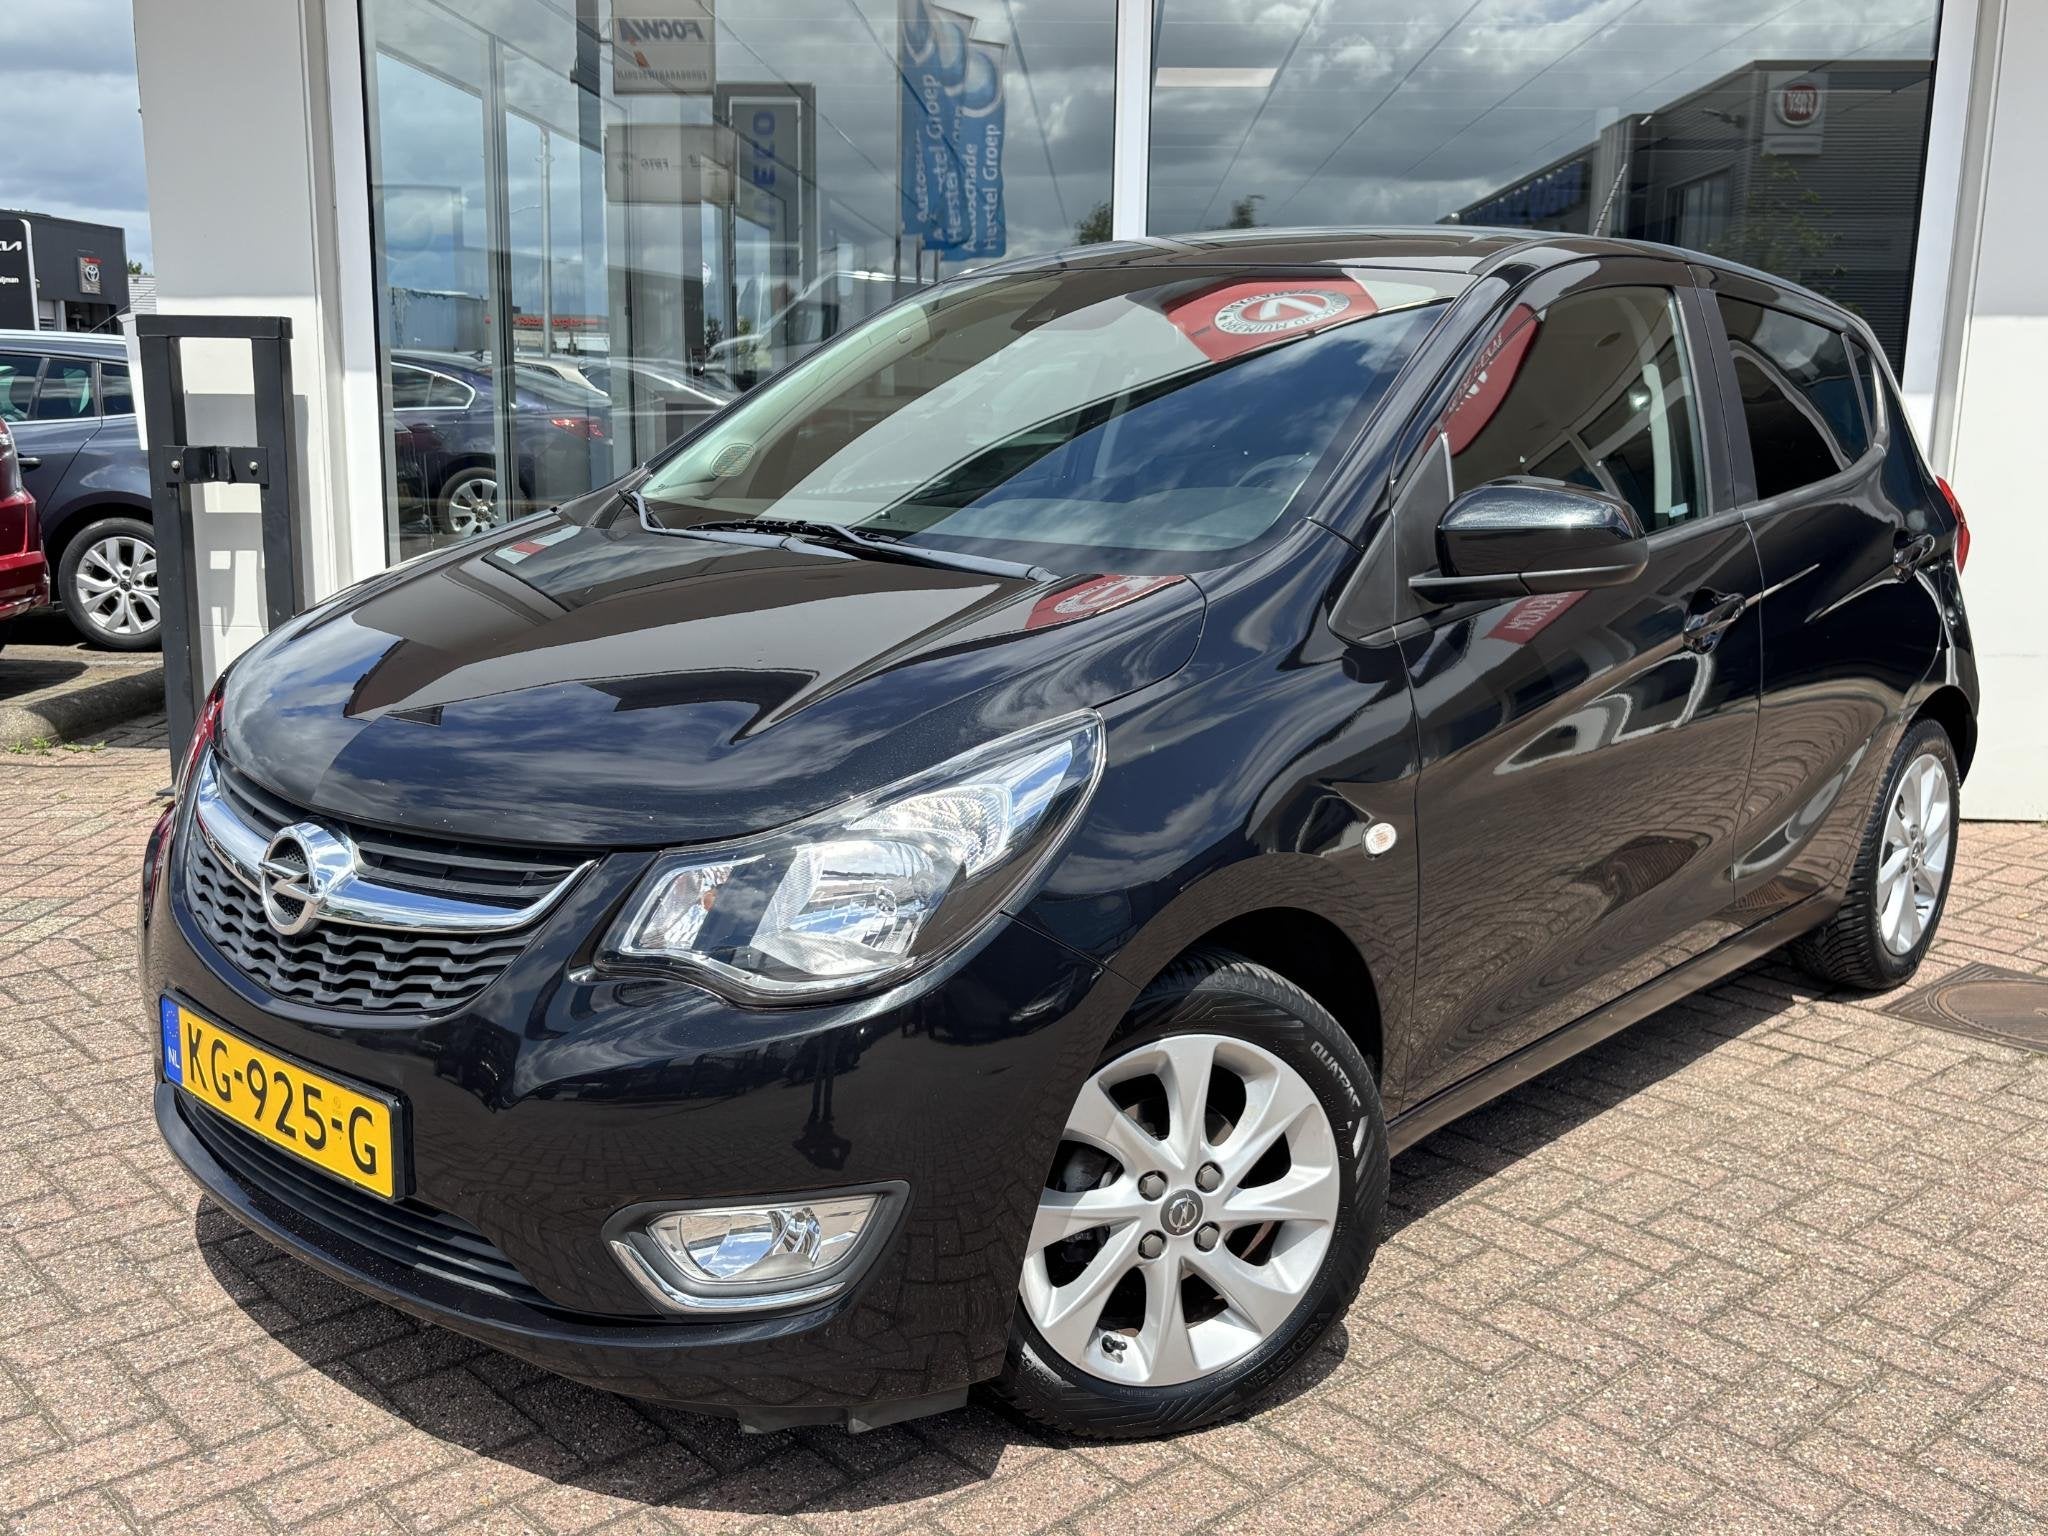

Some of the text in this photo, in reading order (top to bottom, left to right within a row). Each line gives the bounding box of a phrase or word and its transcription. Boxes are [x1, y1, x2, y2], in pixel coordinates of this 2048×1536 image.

[982, 124, 1001, 250] Herstel Groep
[167, 1046, 180, 1069] NL
[187, 1022, 378, 1176] KG-925-G
